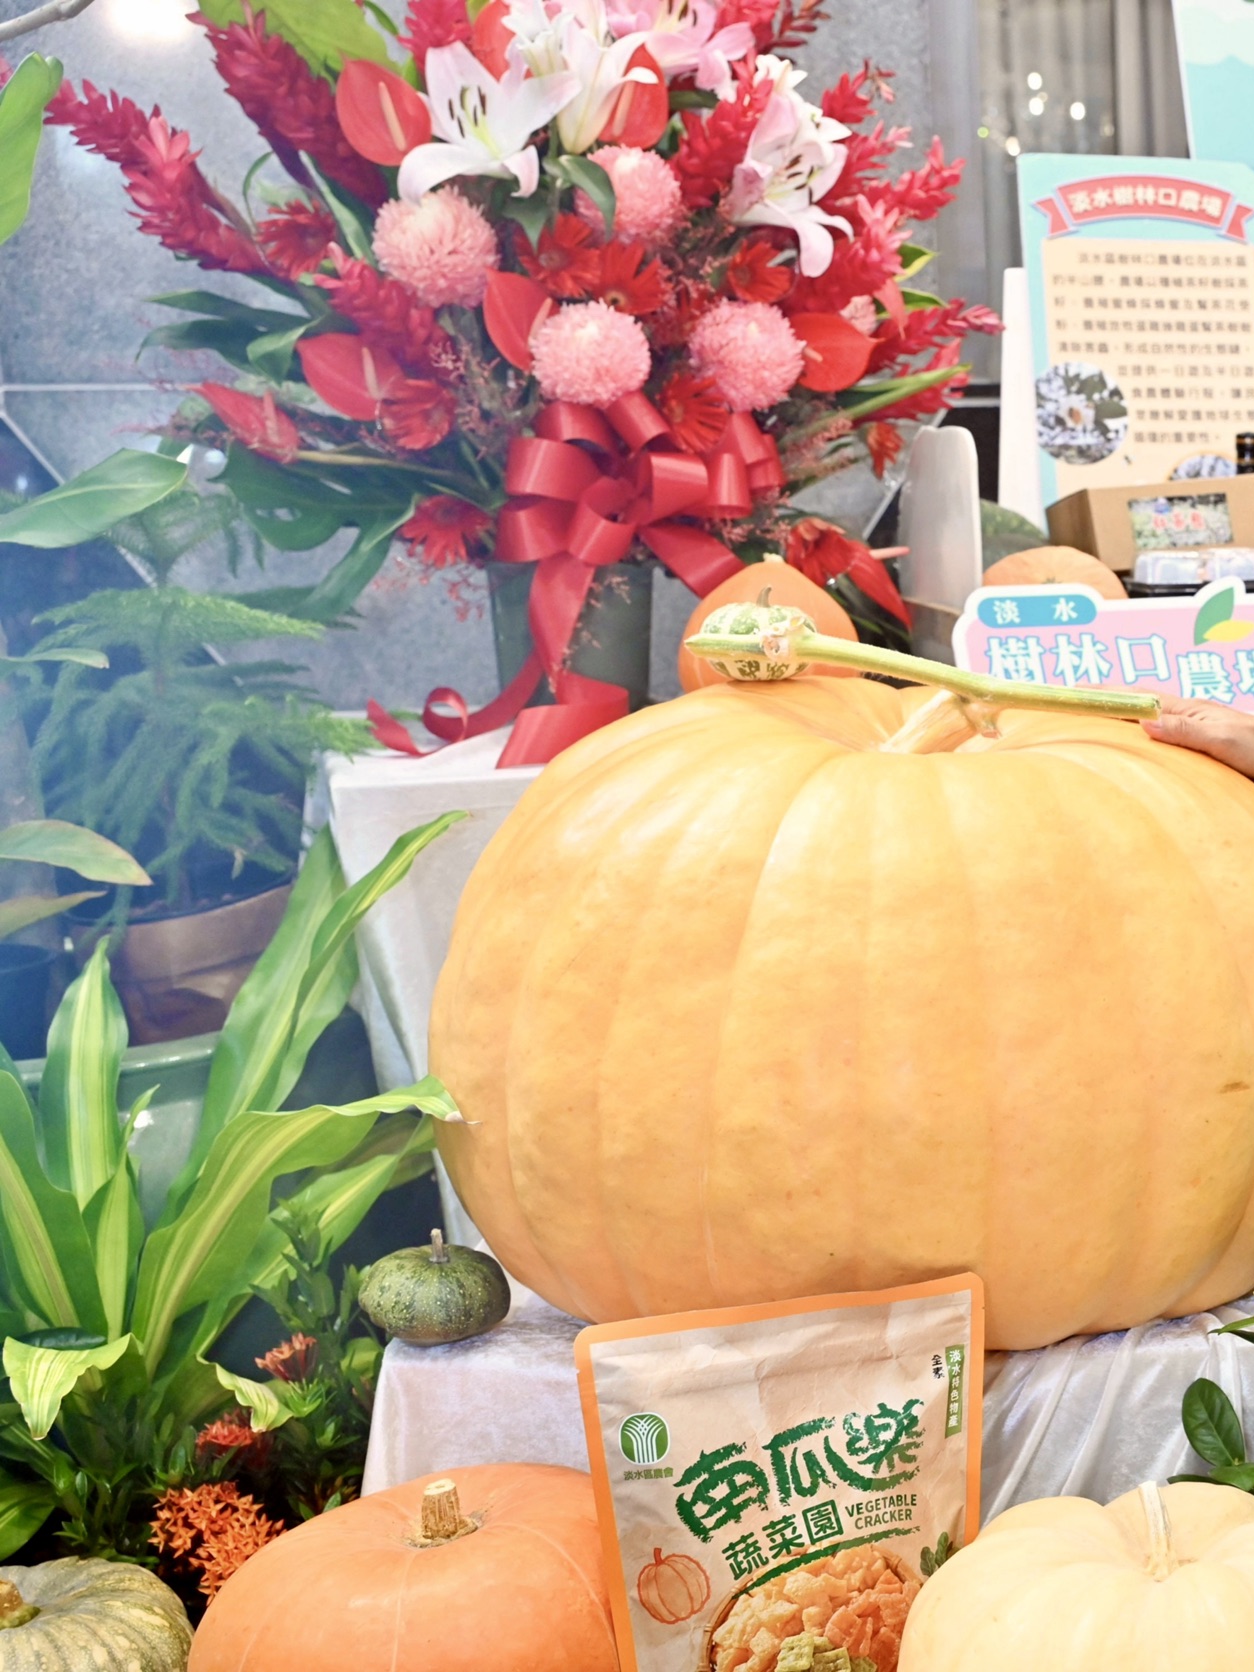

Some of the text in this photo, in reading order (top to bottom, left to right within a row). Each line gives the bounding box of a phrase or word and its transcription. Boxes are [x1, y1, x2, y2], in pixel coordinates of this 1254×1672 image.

[1068, 184, 1223, 218] 淡水樹林口農場
[993, 598, 1078, 625] 淡水
[623, 1467, 674, 1481] 淡水區農會
[673, 1398, 926, 1544] 南瓜樂
[845, 1494, 918, 1518] VEGETABLE
[854, 1509, 913, 1530] CRACKER
[721, 1499, 844, 1581] 蔬菜園
